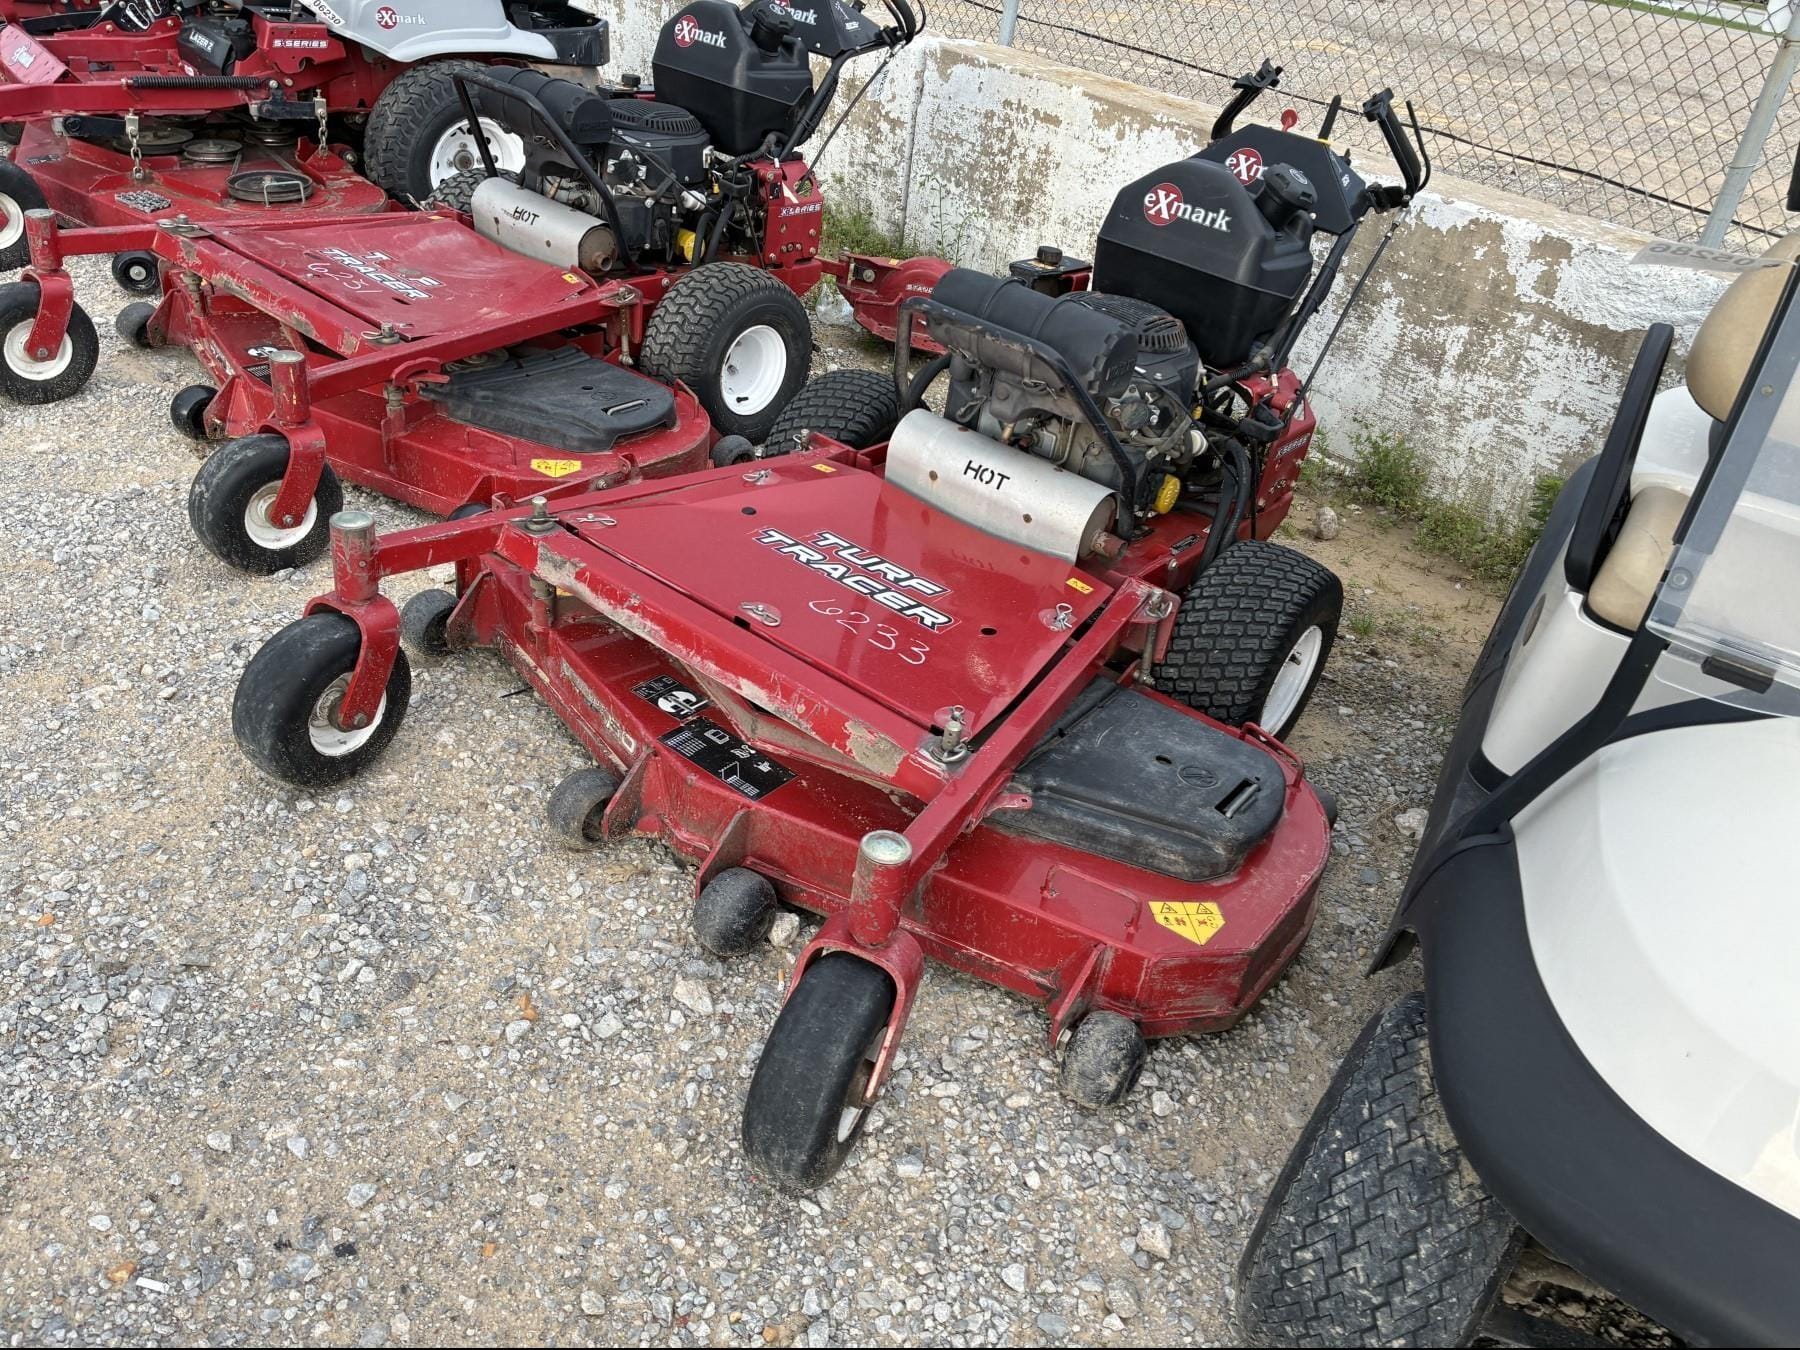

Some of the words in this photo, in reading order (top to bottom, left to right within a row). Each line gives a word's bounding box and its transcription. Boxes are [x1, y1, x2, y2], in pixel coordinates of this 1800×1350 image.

[313, 0, 341, 25] 06230
[375, 9, 427, 26] eXmark
[674, 20, 727, 49] eXmark
[512, 206, 540, 226] HOT
[1143, 188, 1232, 232] eXmark
[321, 248, 432, 299] TRACER
[963, 460, 1010, 490] HOT
[754, 528, 953, 630] TRACER
[814, 531, 951, 596] TURF
[808, 599, 931, 665] 6233
